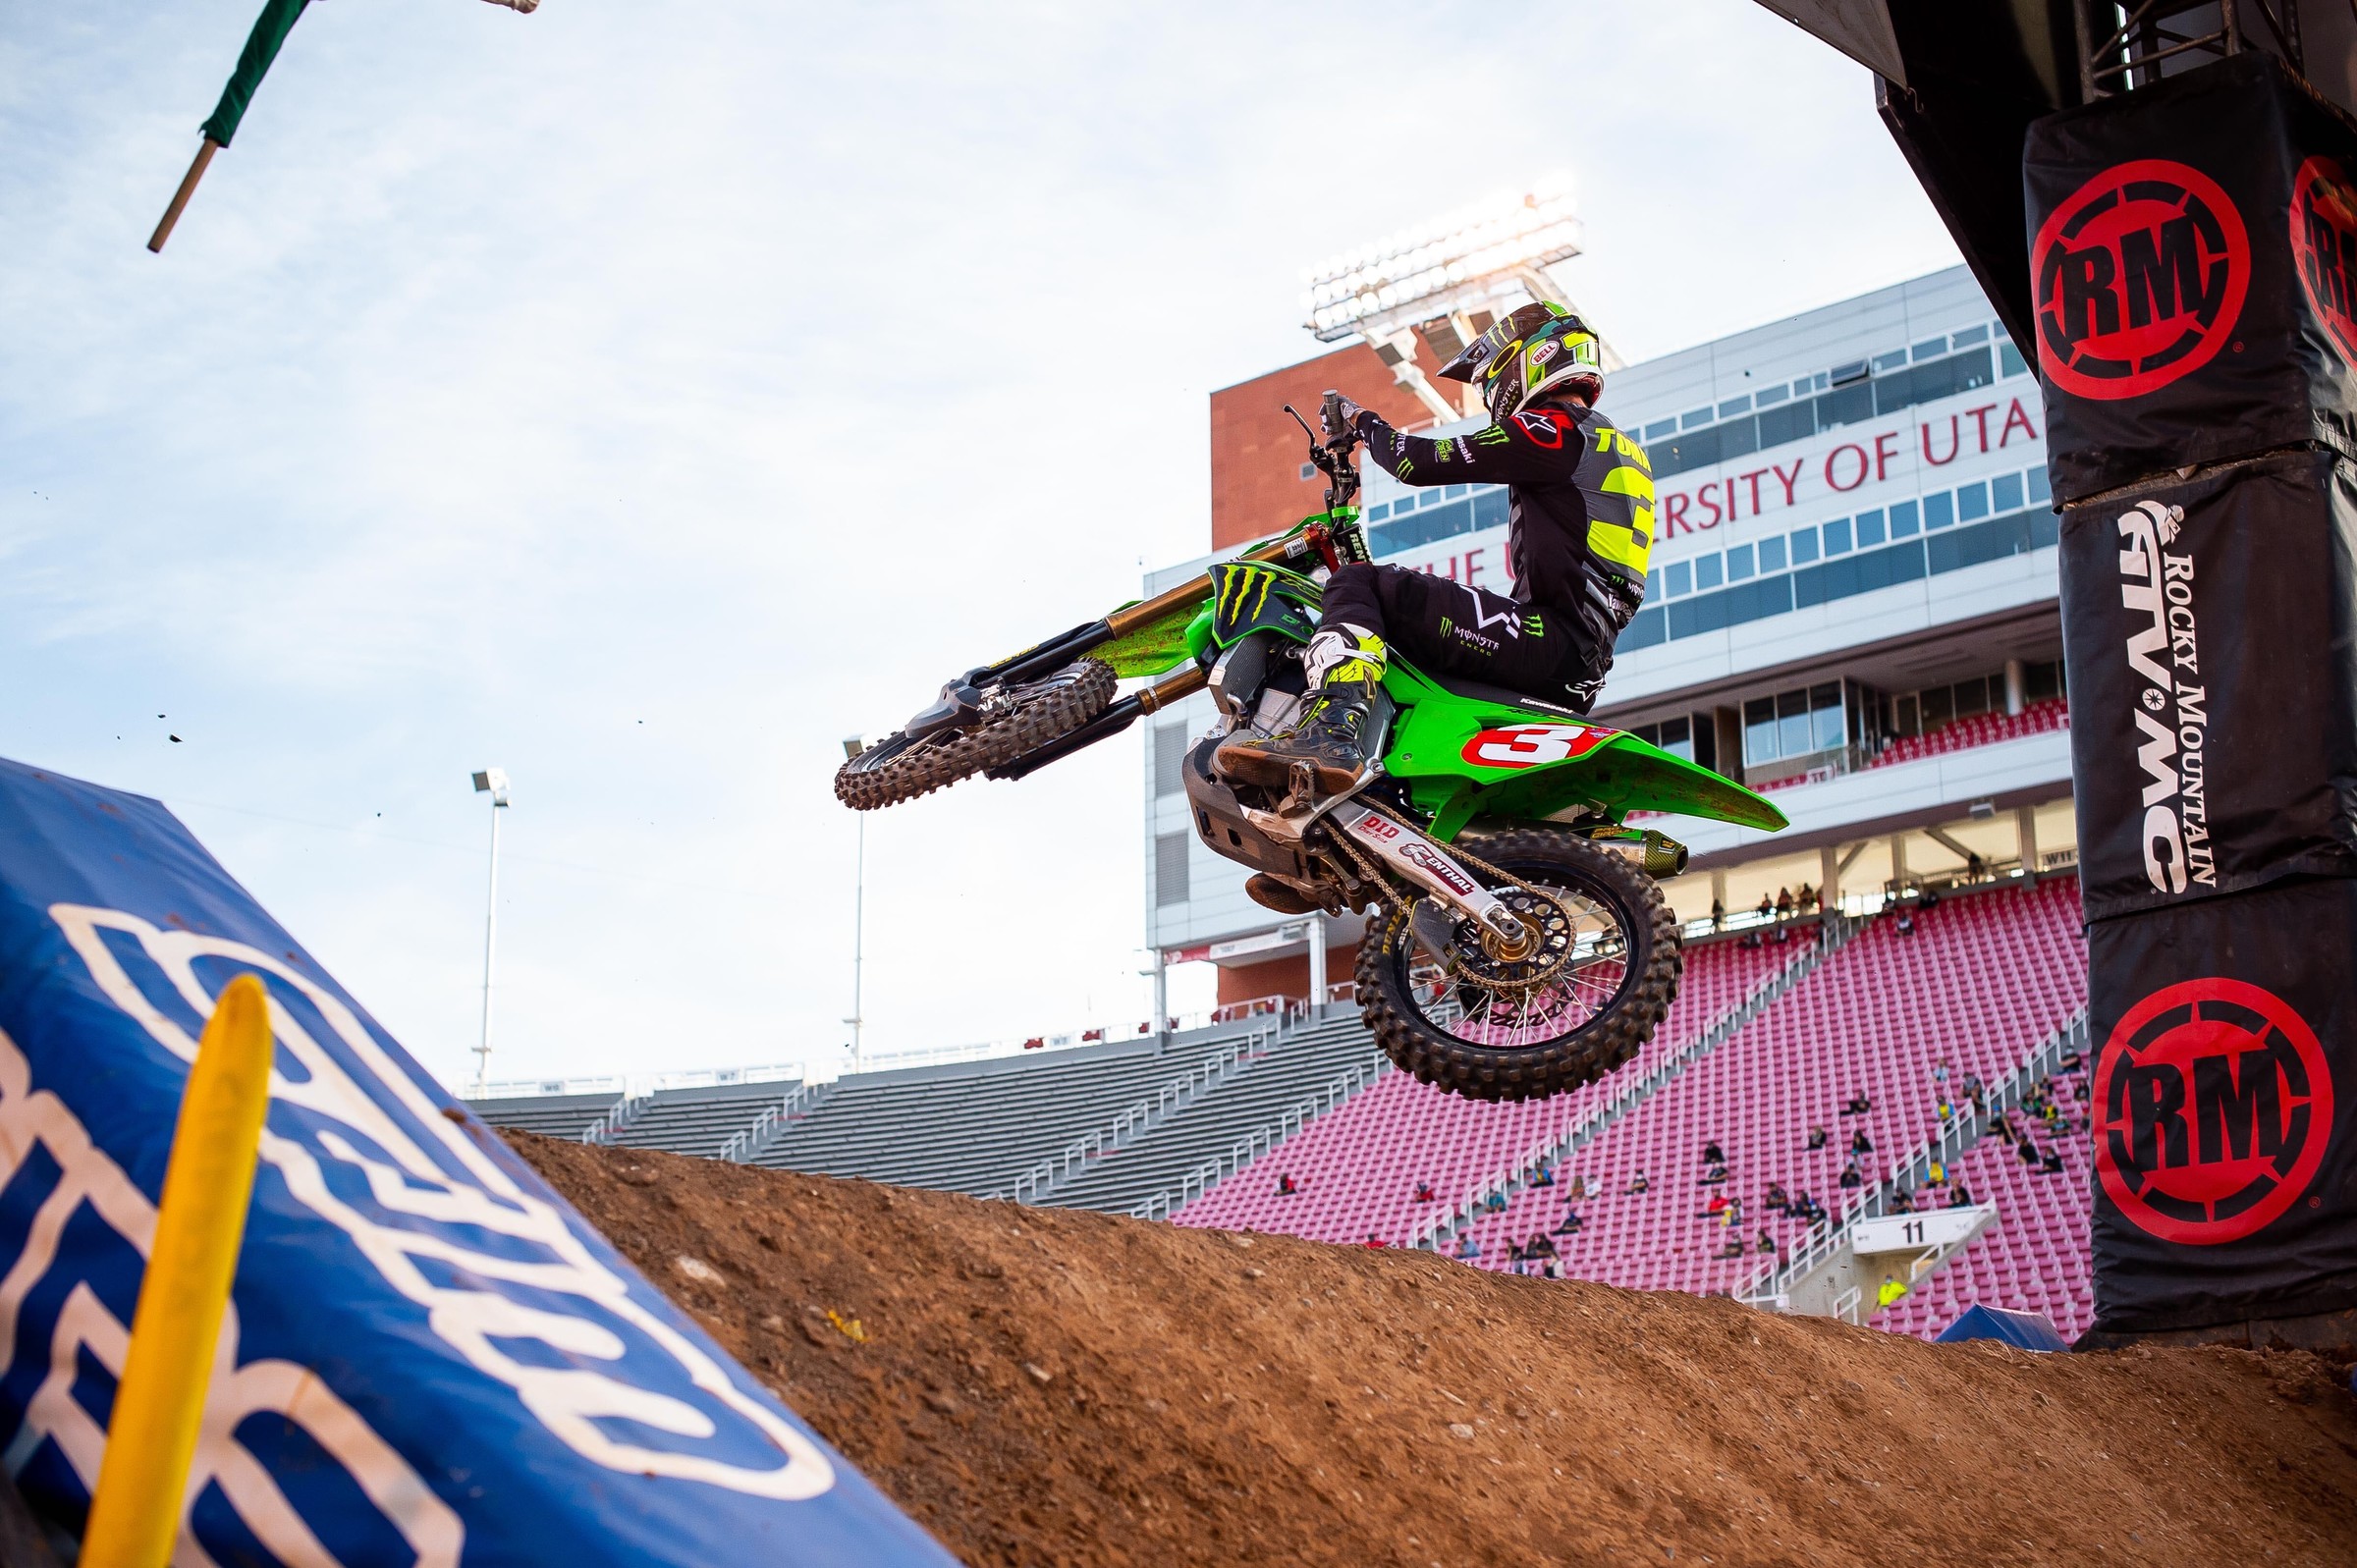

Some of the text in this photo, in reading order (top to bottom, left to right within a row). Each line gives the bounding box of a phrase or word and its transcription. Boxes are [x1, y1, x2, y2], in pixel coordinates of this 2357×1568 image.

[2062, 215, 2201, 343] RM
[1533, 345, 1556, 363] BELL
[1595, 428, 1652, 472] TOMA
[1825, 432, 1898, 491] OF
[1921, 398, 2038, 466] UTA
[1477, 724, 1586, 764] 3
[2164, 552, 2217, 888] ROCKY MOUNTAIN
[2130, 1049, 2276, 1171] RM
[1902, 1220, 1923, 1243] 11
